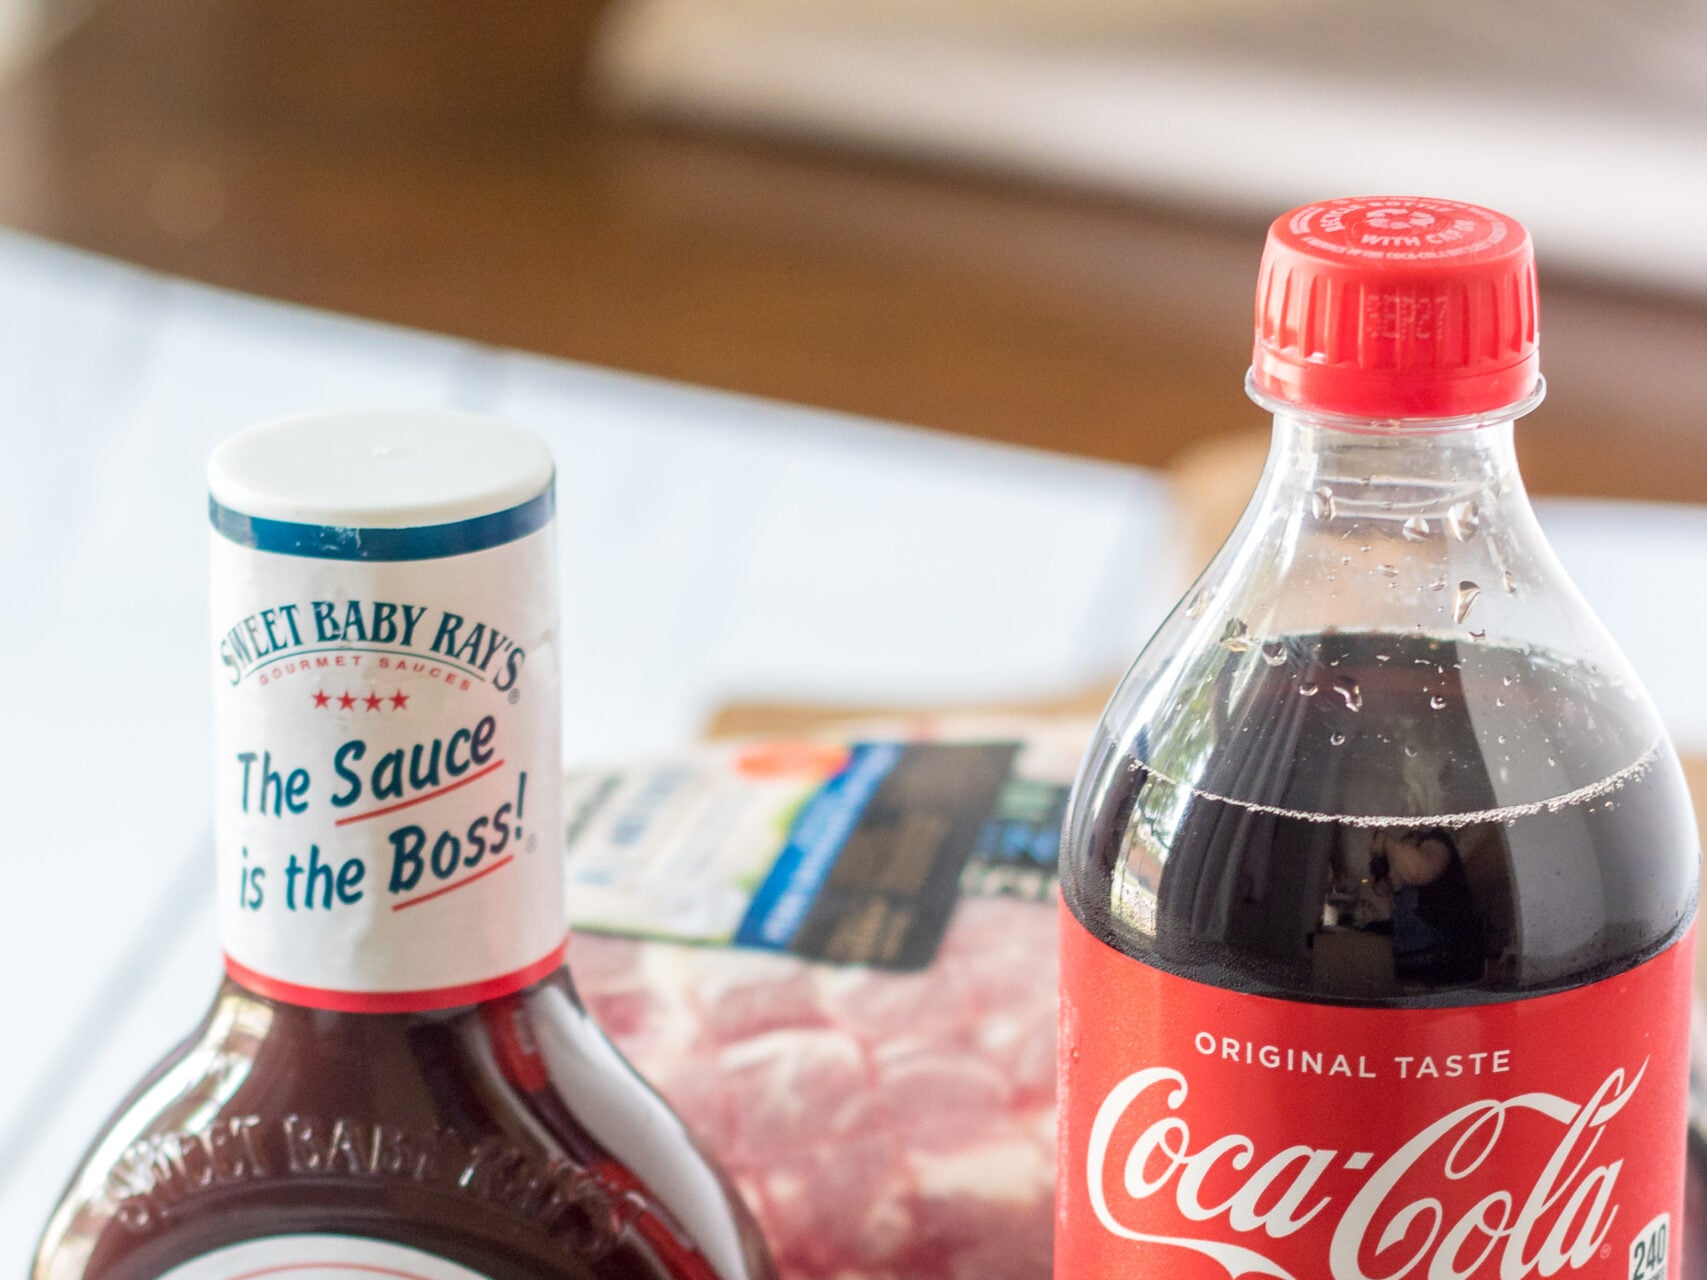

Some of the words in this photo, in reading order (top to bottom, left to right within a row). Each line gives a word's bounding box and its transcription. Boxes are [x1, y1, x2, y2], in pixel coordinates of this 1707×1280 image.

[1361, 234, 1421, 247] WITH
[220, 604, 304, 687] SWEET
[311, 599, 428, 647] BABY
[430, 611, 526, 692] RAY'S
[258, 655, 363, 686] GOURMET
[378, 657, 472, 692] SAUCES
[237, 750, 311, 818] The
[330, 715, 497, 808] Sauce
[239, 845, 266, 911] is
[284, 843, 366, 912] the
[387, 770, 528, 895] Boss!
[1194, 1030, 1377, 1080] ORIGINAL
[1394, 1048, 1512, 1080] TASTE
